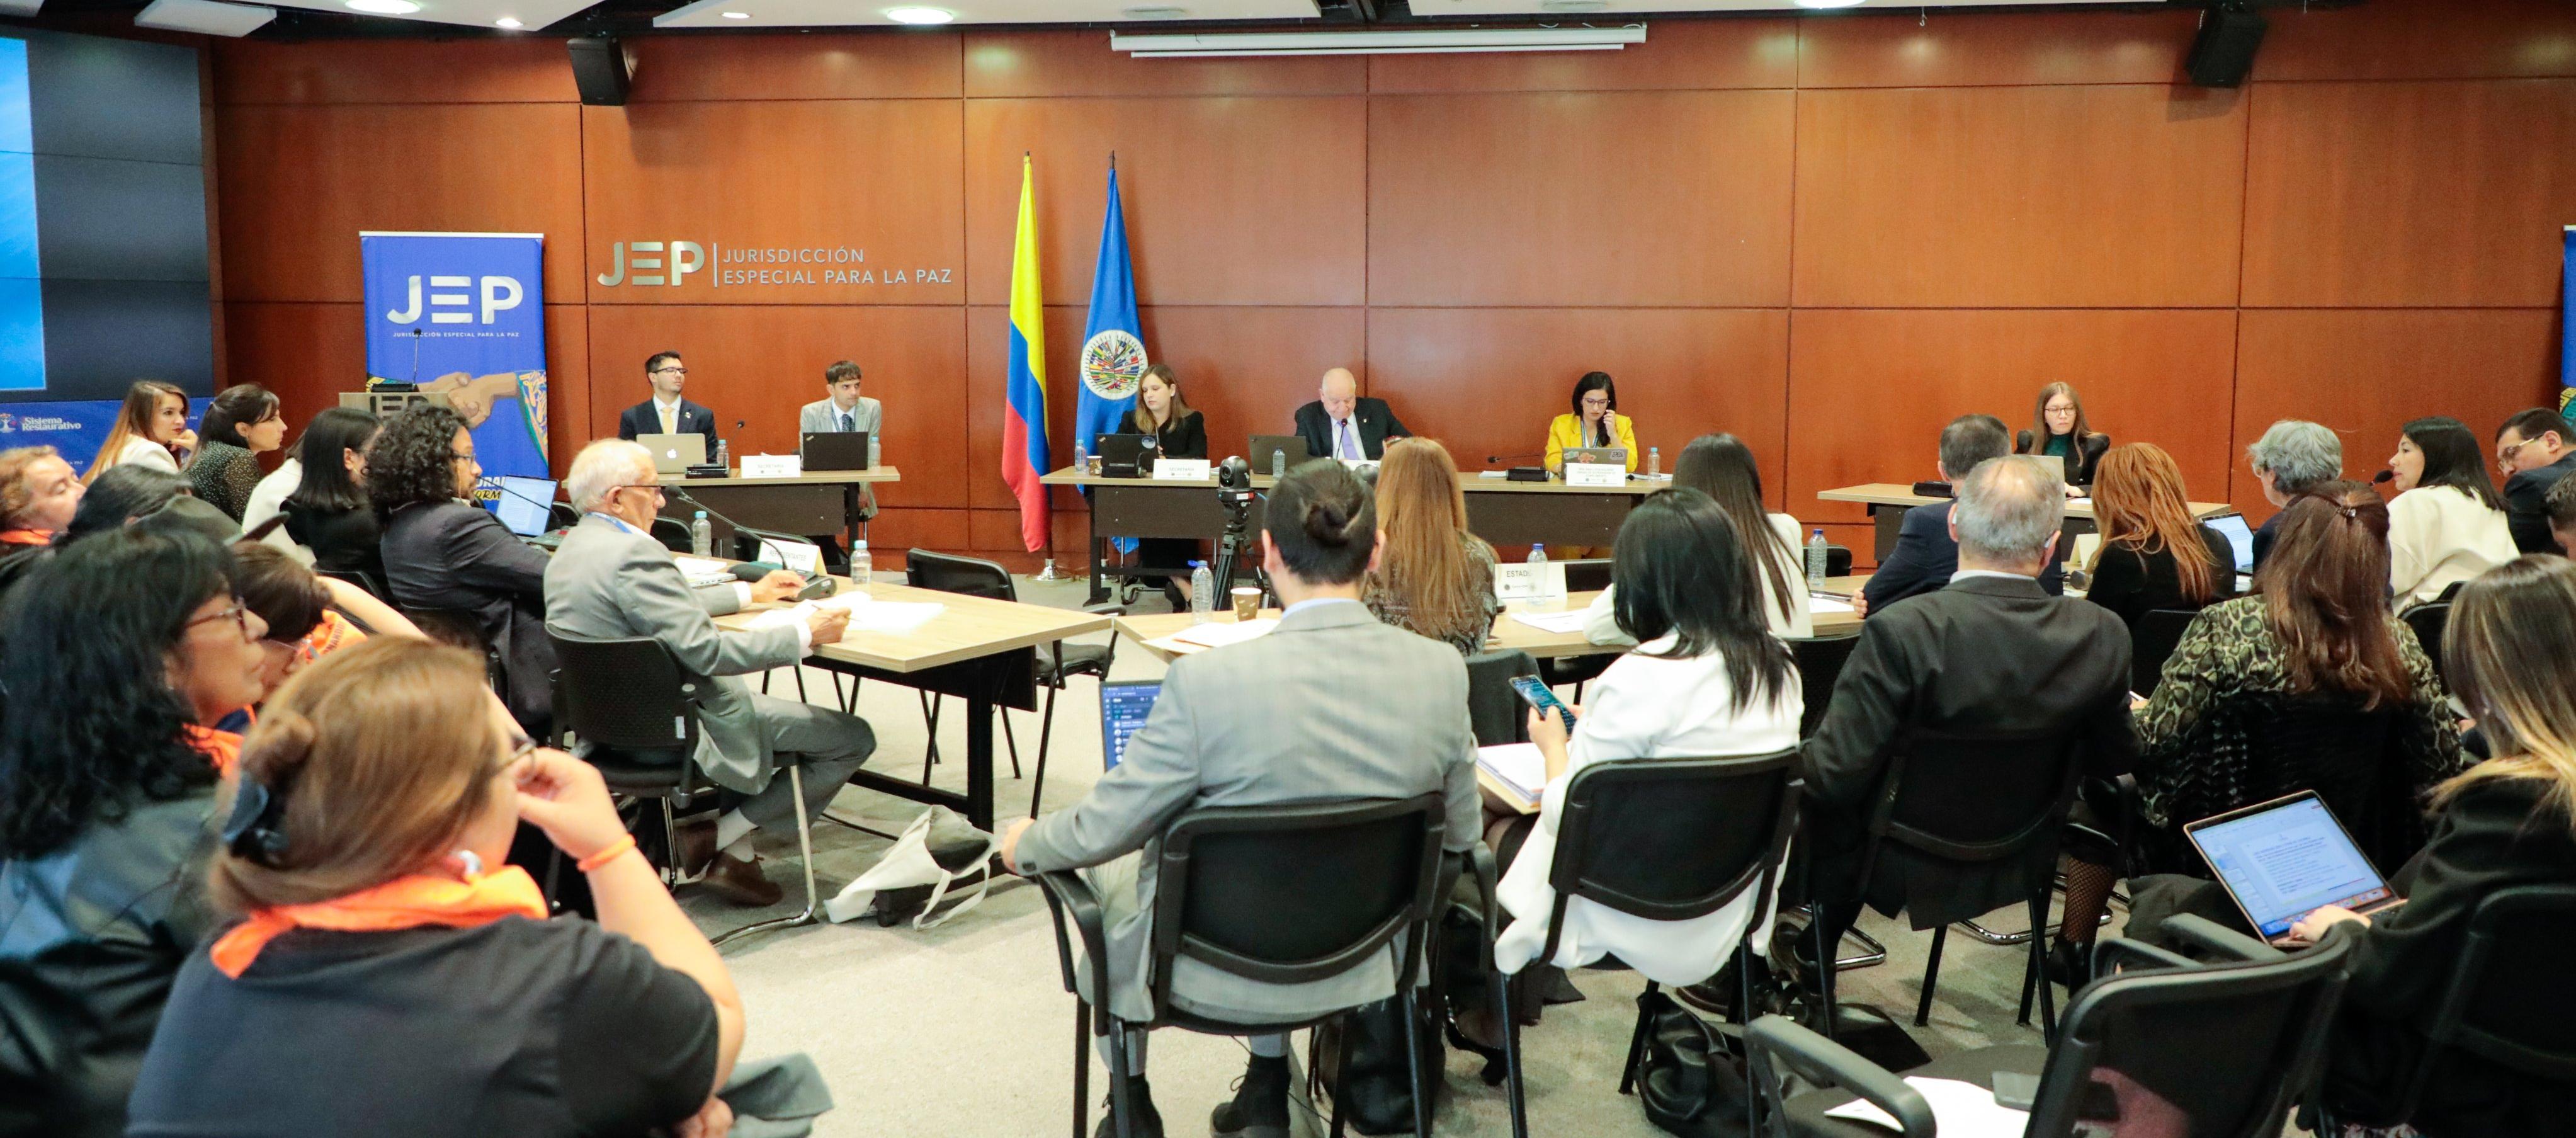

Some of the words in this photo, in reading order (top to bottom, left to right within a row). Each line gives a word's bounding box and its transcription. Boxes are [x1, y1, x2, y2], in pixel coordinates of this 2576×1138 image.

[723, 246, 864, 263] JURISDICCIÓN
[598, 241, 705, 286] JEP
[724, 270, 816, 284] ESPECIAL
[825, 270, 874, 283] PARA
[884, 270, 907, 283] LA
[916, 269, 951, 283] PAZ
[387, 275, 523, 324] JEP
[22, 421, 82, 431] Restaurativo
